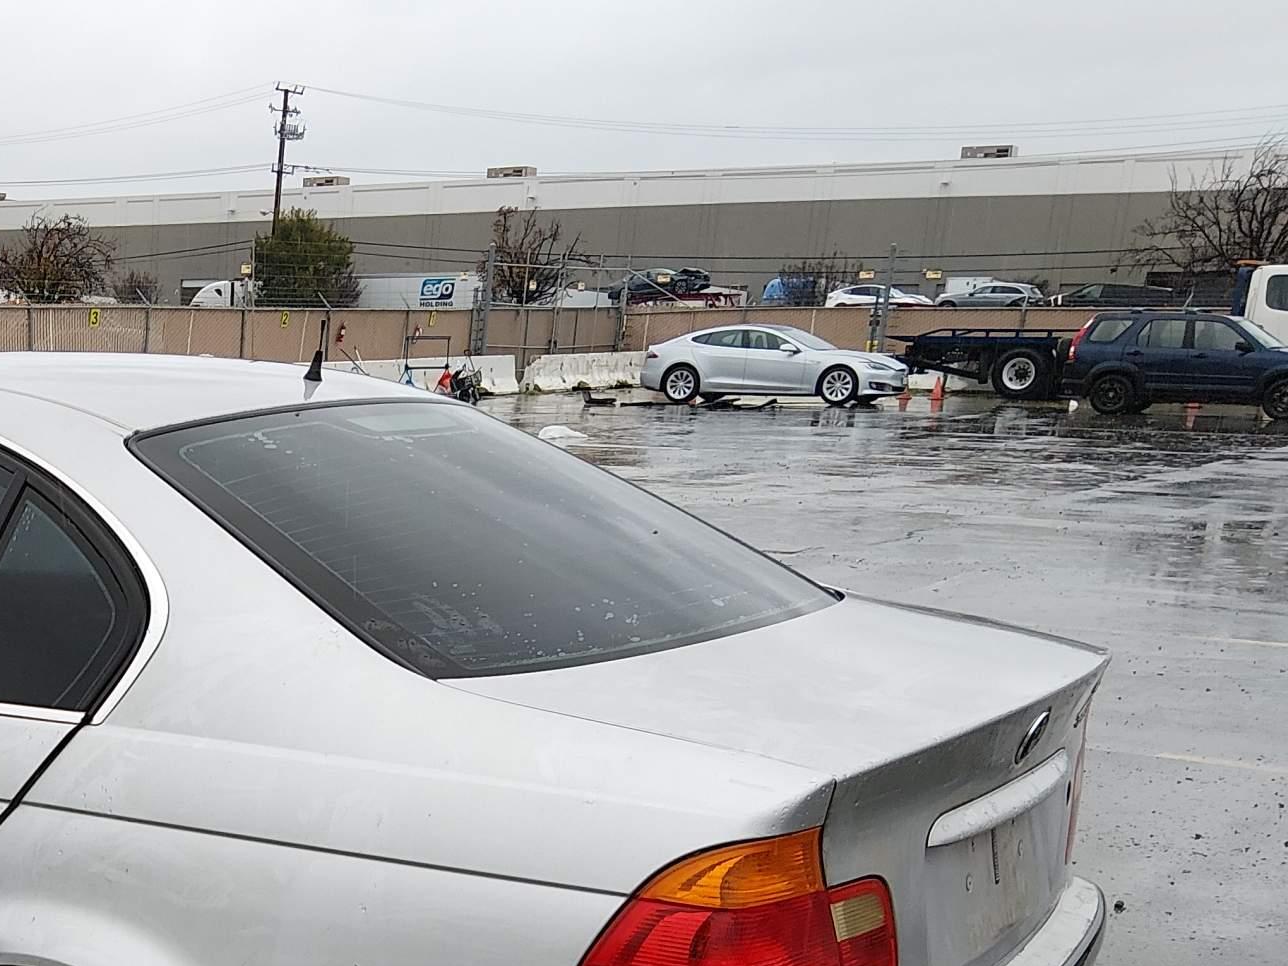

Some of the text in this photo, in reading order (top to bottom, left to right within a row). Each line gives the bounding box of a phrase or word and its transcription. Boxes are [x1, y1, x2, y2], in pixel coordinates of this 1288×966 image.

[422, 282, 454, 298] ego
[91, 311, 99, 325] 3
[282, 312, 289, 325] 2
